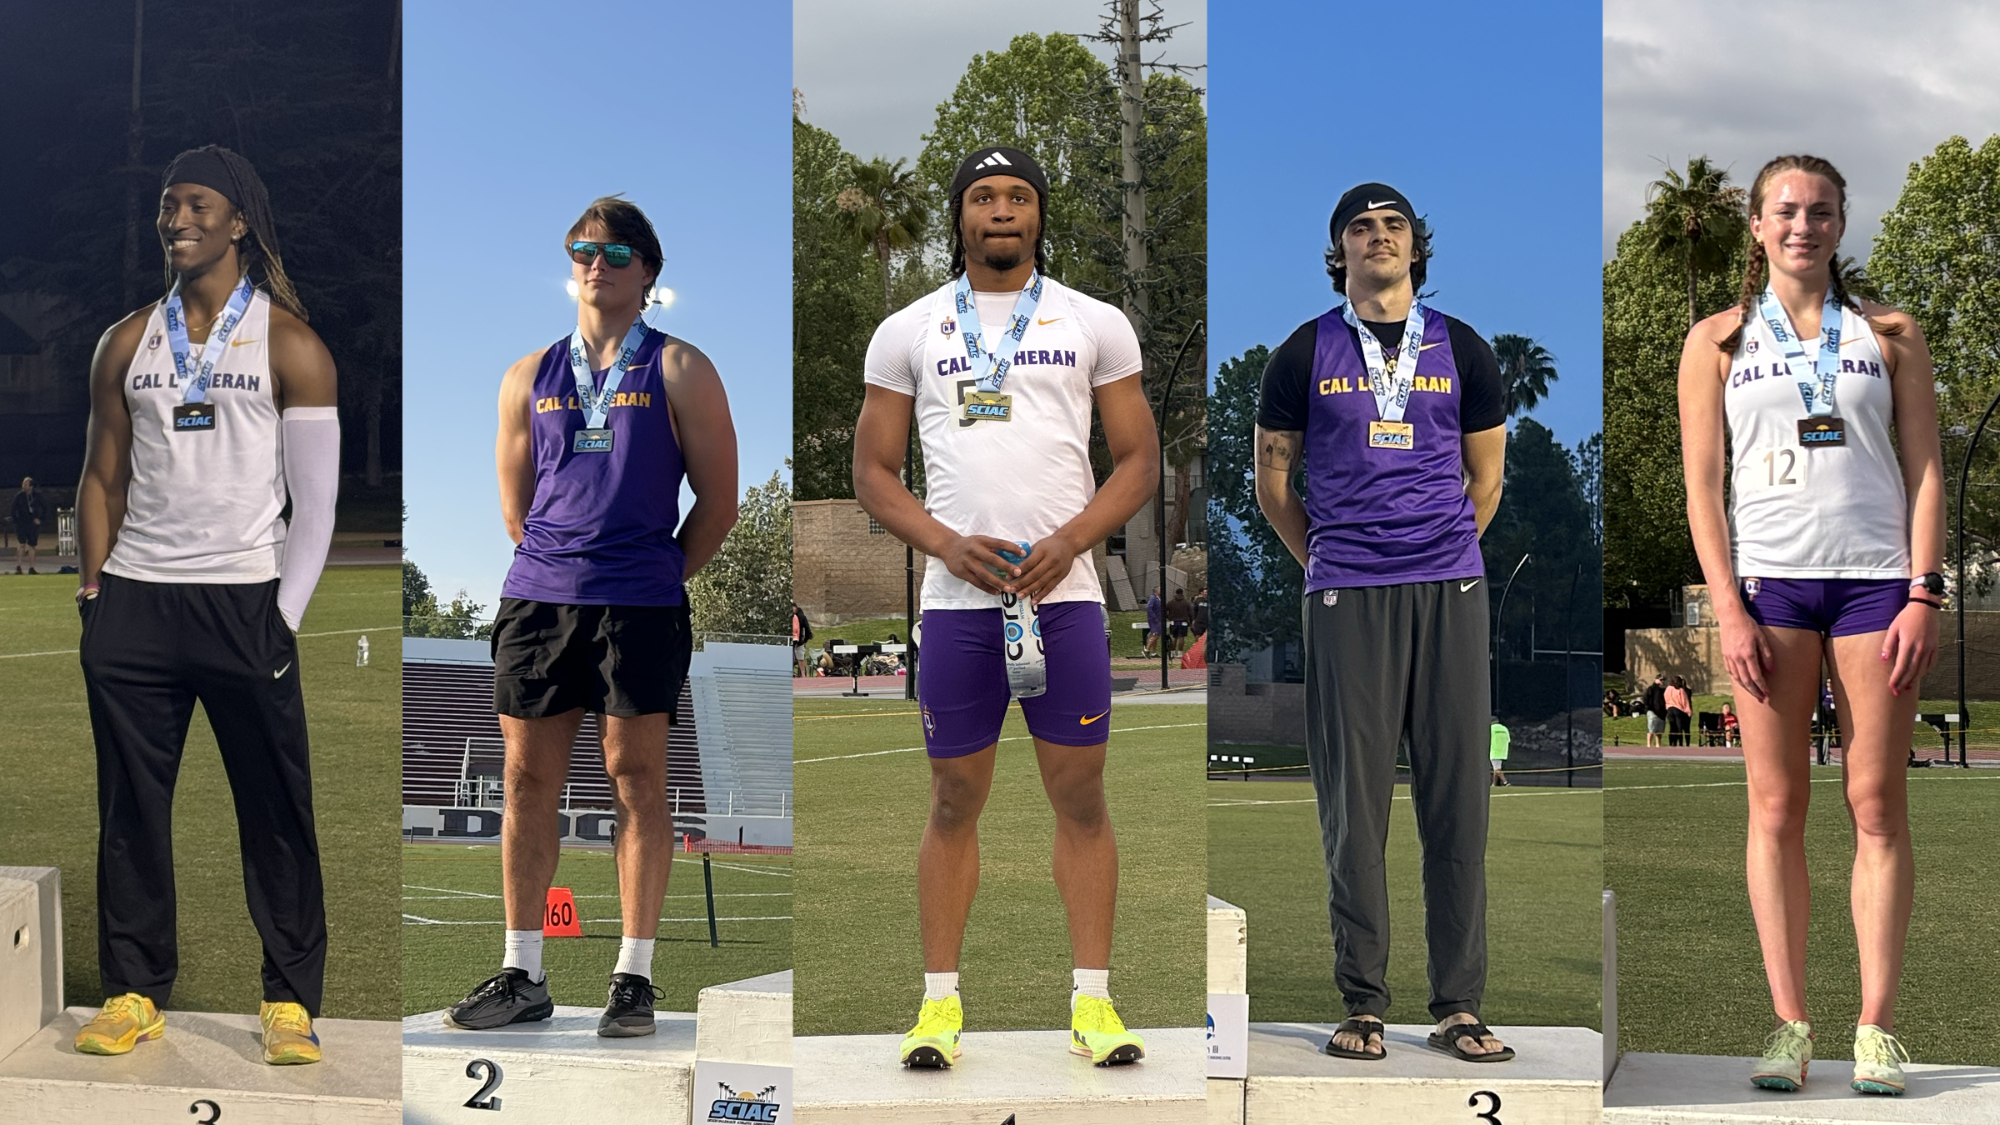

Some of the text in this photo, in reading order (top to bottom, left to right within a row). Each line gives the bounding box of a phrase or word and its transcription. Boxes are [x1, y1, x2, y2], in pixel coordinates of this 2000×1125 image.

[1012, 314, 1030, 342] SCIAC
[963, 332, 980, 359] SCIAC
[936, 356, 972, 377] CAL
[991, 358, 1011, 390] SCIAC
[1733, 363, 1765, 389] CAL
[132, 373, 260, 392] CAL LERAN
[1319, 377, 1353, 396] CAL
[536, 392, 651, 414] CAL LERAN
[967, 404, 1010, 417] SCIAC
[176, 416, 212, 427] SCIAC
[576, 439, 611, 449] SCIAC
[1372, 433, 1411, 446] SCIAC
[1802, 431, 1843, 442] SCIAC
[1763, 449, 1796, 486] 12
[1002, 590, 1023, 661] core
[546, 902, 572, 926] 160
[463, 1058, 503, 1111] 2
[190, 1099, 221, 1125] 3
[709, 1100, 780, 1122] SCIAC
[1468, 1090, 1503, 1125] 3
